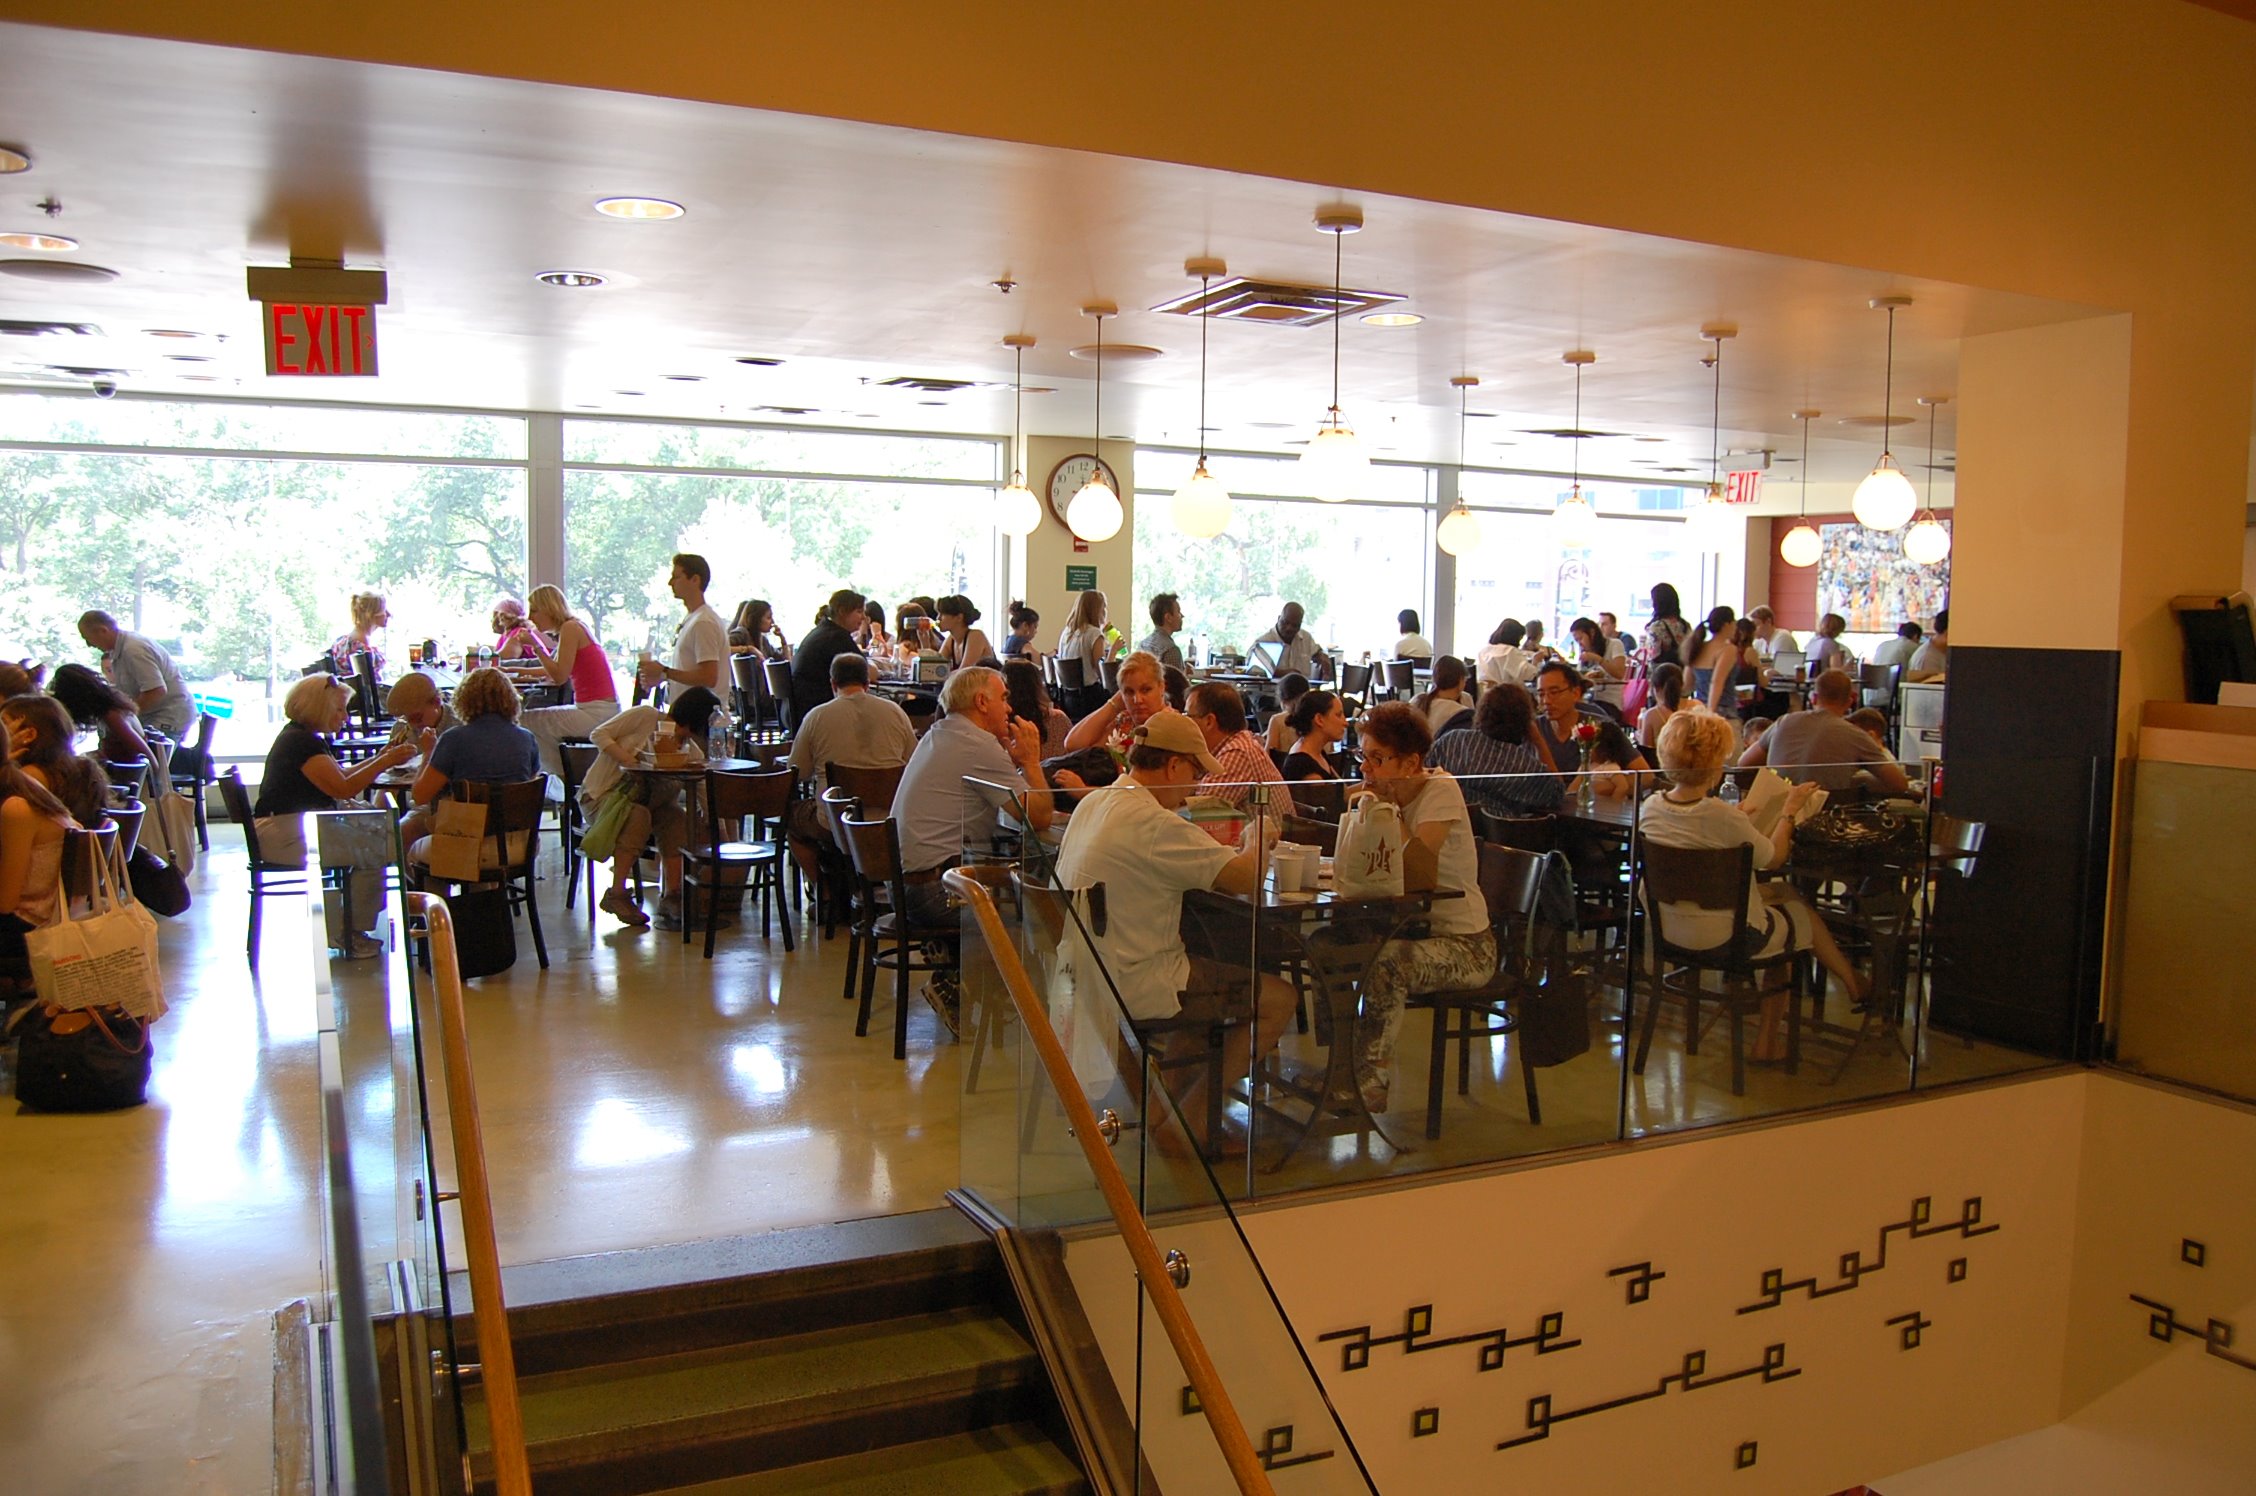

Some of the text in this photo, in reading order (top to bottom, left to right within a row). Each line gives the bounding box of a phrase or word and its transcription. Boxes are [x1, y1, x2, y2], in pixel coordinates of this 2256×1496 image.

[272, 304, 366, 374] EXIT
[1067, 465, 1075, 474] 11
[1080, 462, 1088, 471] 12
[1058, 474, 1067, 483] 10
[1726, 471, 1758, 502] EXIT
[1053, 488, 1059, 496] 9
[1057, 502, 1063, 511] 8
